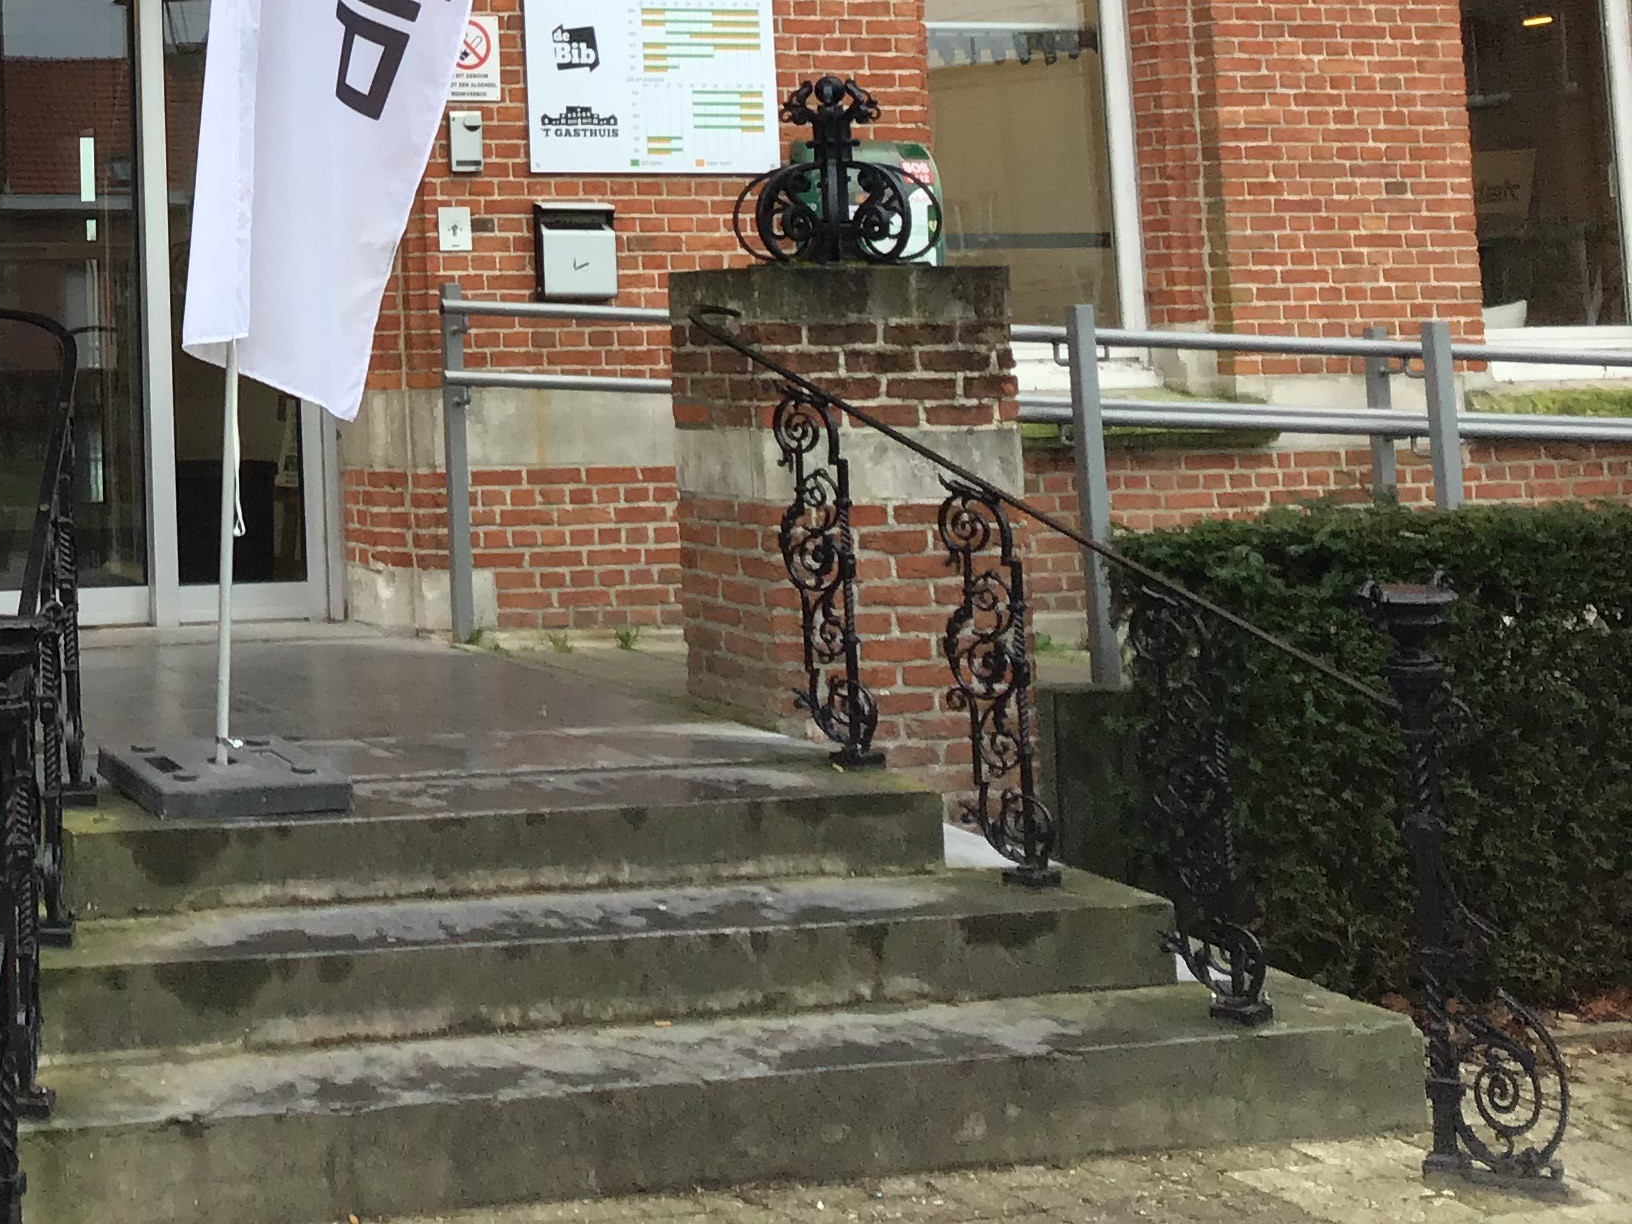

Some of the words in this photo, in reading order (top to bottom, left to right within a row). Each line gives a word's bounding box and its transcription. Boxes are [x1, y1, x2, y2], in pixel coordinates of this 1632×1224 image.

[553, 28, 570, 42] de
[553, 42, 596, 64] Bib
[554, 128, 619, 138] GASTHUIS
